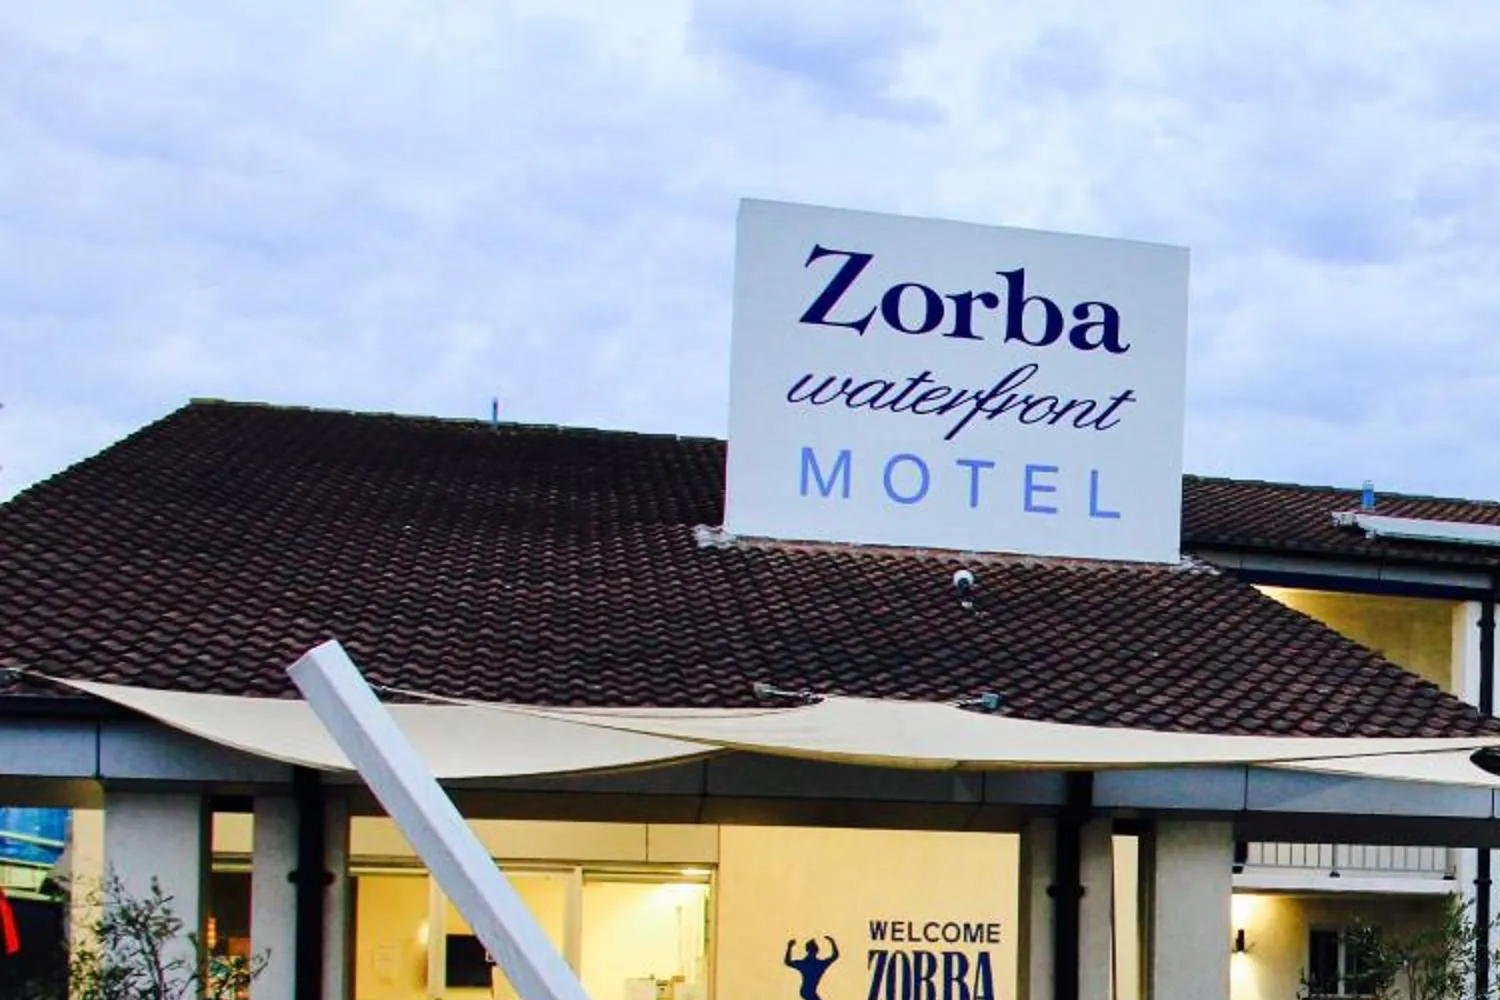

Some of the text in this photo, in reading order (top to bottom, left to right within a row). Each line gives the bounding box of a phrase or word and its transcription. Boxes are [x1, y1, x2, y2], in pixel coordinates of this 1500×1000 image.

[799, 243, 1131, 355] Zorba
[787, 363, 1137, 441] waterfront
[800, 446, 1121, 519] MOTEL
[869, 920, 1001, 943] WELCOME
